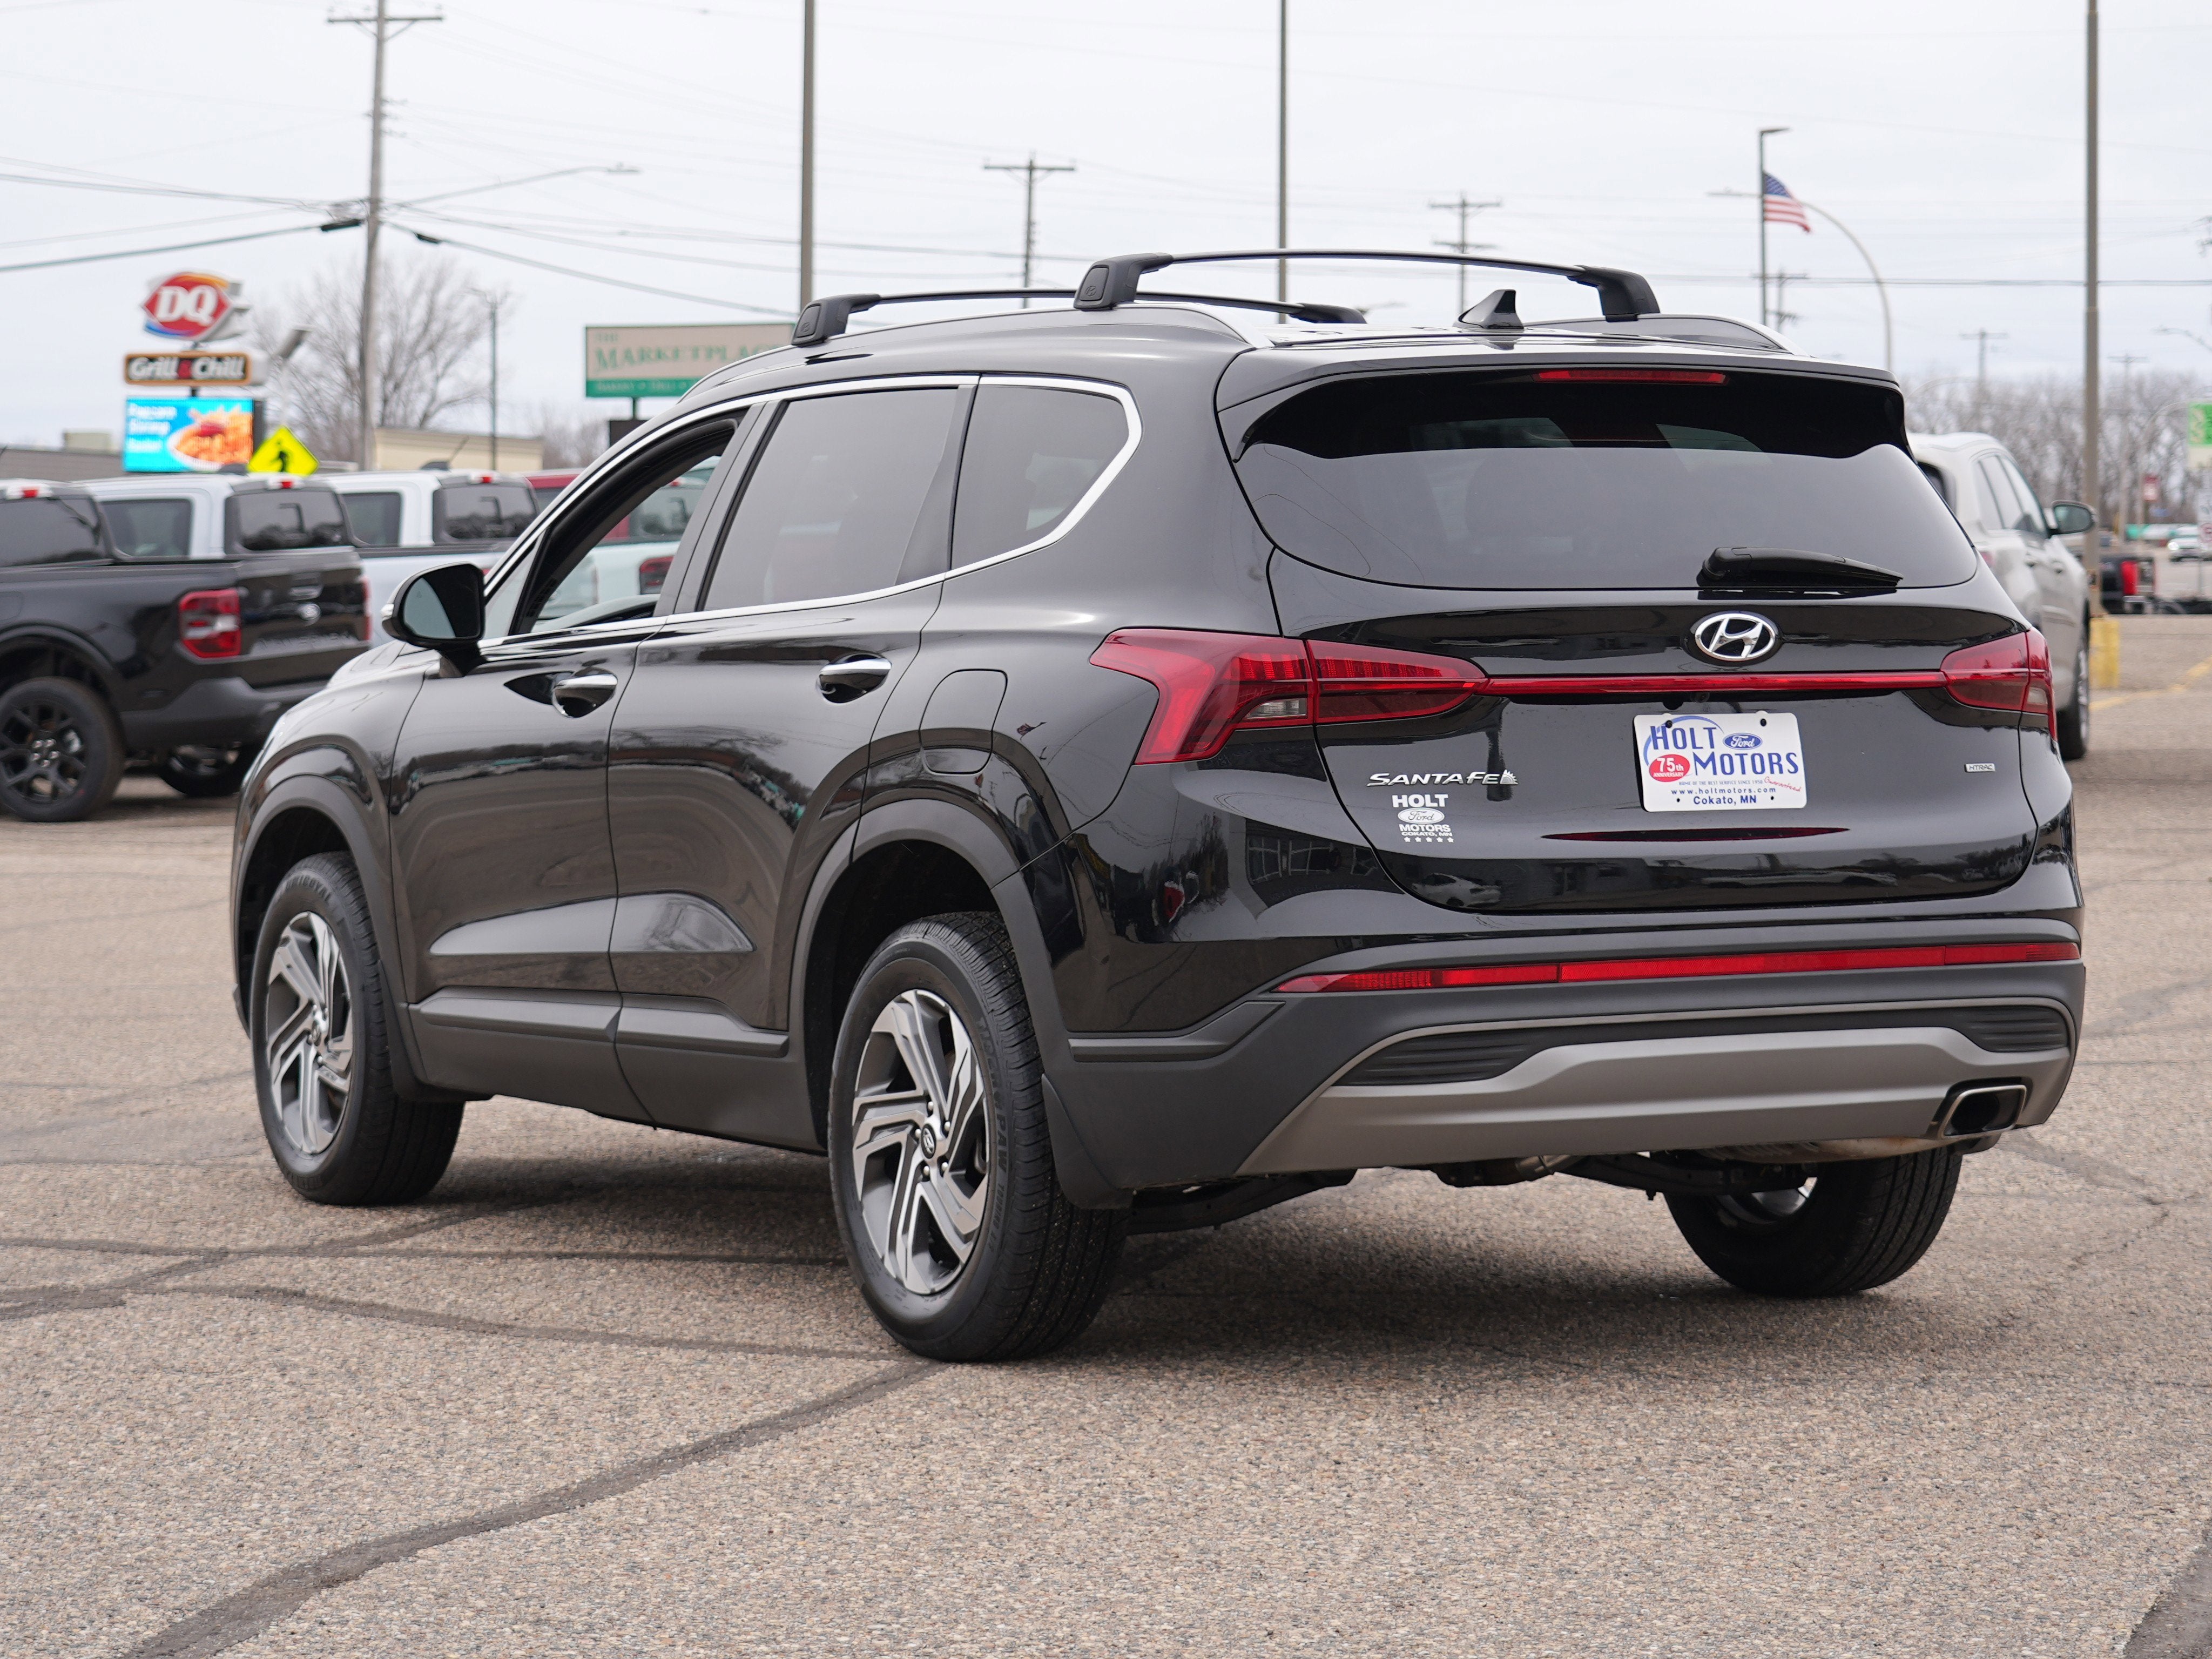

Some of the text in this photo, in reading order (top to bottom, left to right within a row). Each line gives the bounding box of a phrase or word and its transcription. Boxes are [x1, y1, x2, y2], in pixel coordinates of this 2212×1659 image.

[156, 285, 217, 326] DQ
[129, 356, 245, 379] Grill Chill
[1650, 726, 1717, 750] HOLT
[1731, 735, 1755, 747] Ford
[1657, 758, 1684, 772] 75th
[1693, 751, 1799, 776] MOTORS
[1367, 772, 1464, 786] SANTA
[1392, 794, 1449, 807] HOLT
[1694, 795, 1756, 805] Cokato, MN
[1407, 811, 1434, 821] Ford
[1399, 824, 1451, 832] MOTORS
[997, 1114, 1007, 1173] PAW
